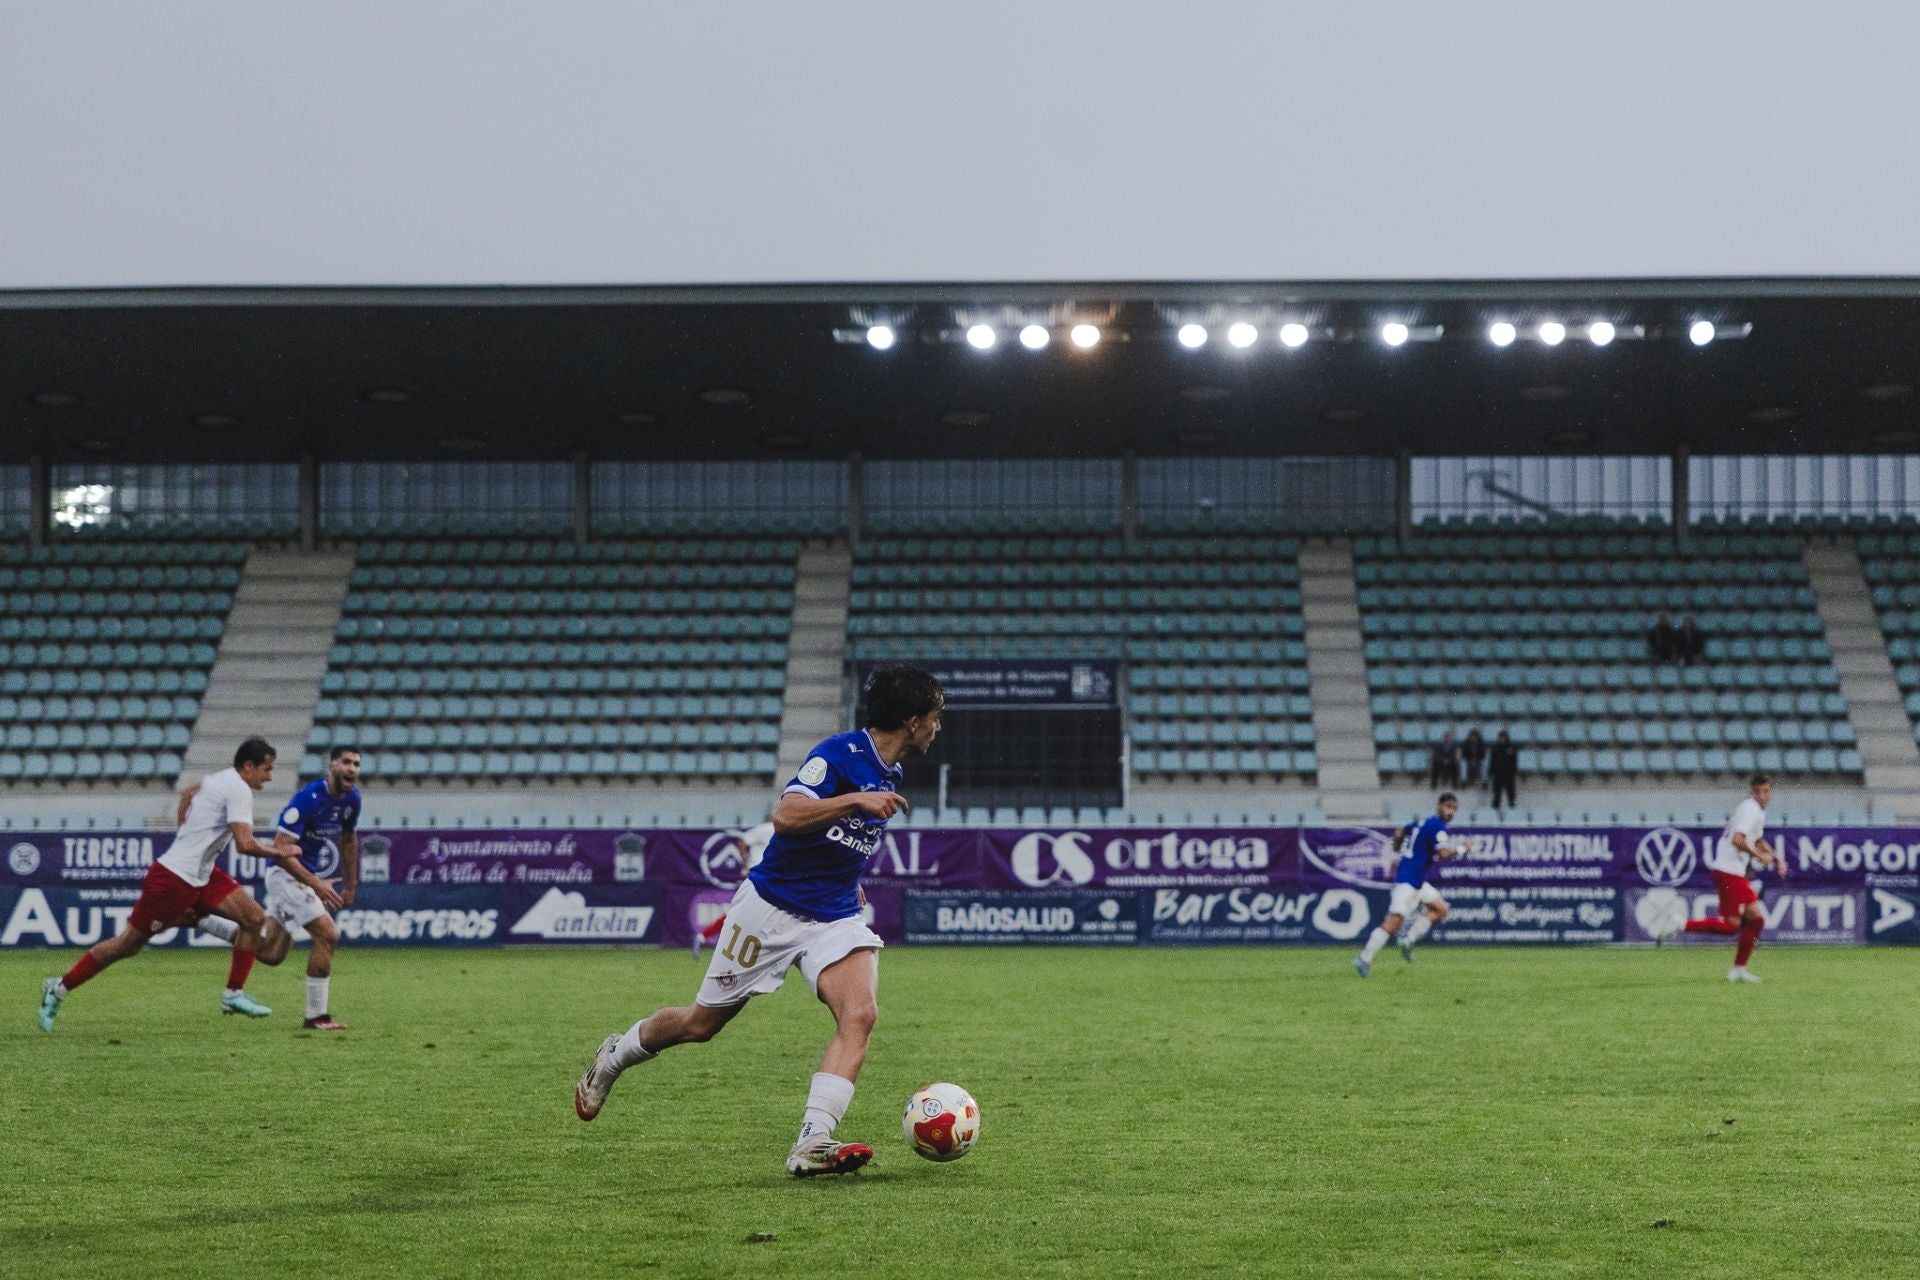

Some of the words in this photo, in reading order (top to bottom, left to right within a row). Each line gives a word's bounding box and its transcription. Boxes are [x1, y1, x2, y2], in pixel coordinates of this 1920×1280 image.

[63, 837, 153, 868] TERCERA
[419, 837, 552, 862] Ayuntamiento
[554, 834, 577, 856] de
[1104, 832, 1269, 870] ortega
[1509, 834, 1614, 861] INDUSTRIAL
[1798, 835, 1920, 871] Motor
[406, 864, 432, 884] La
[437, 861, 482, 884] Villa
[485, 861, 508, 884] de
[335, 909, 498, 938] FERRETEROS
[553, 908, 639, 933] antolin
[937, 903, 1074, 932] BAÑOSALUD
[721, 922, 762, 969] 10
